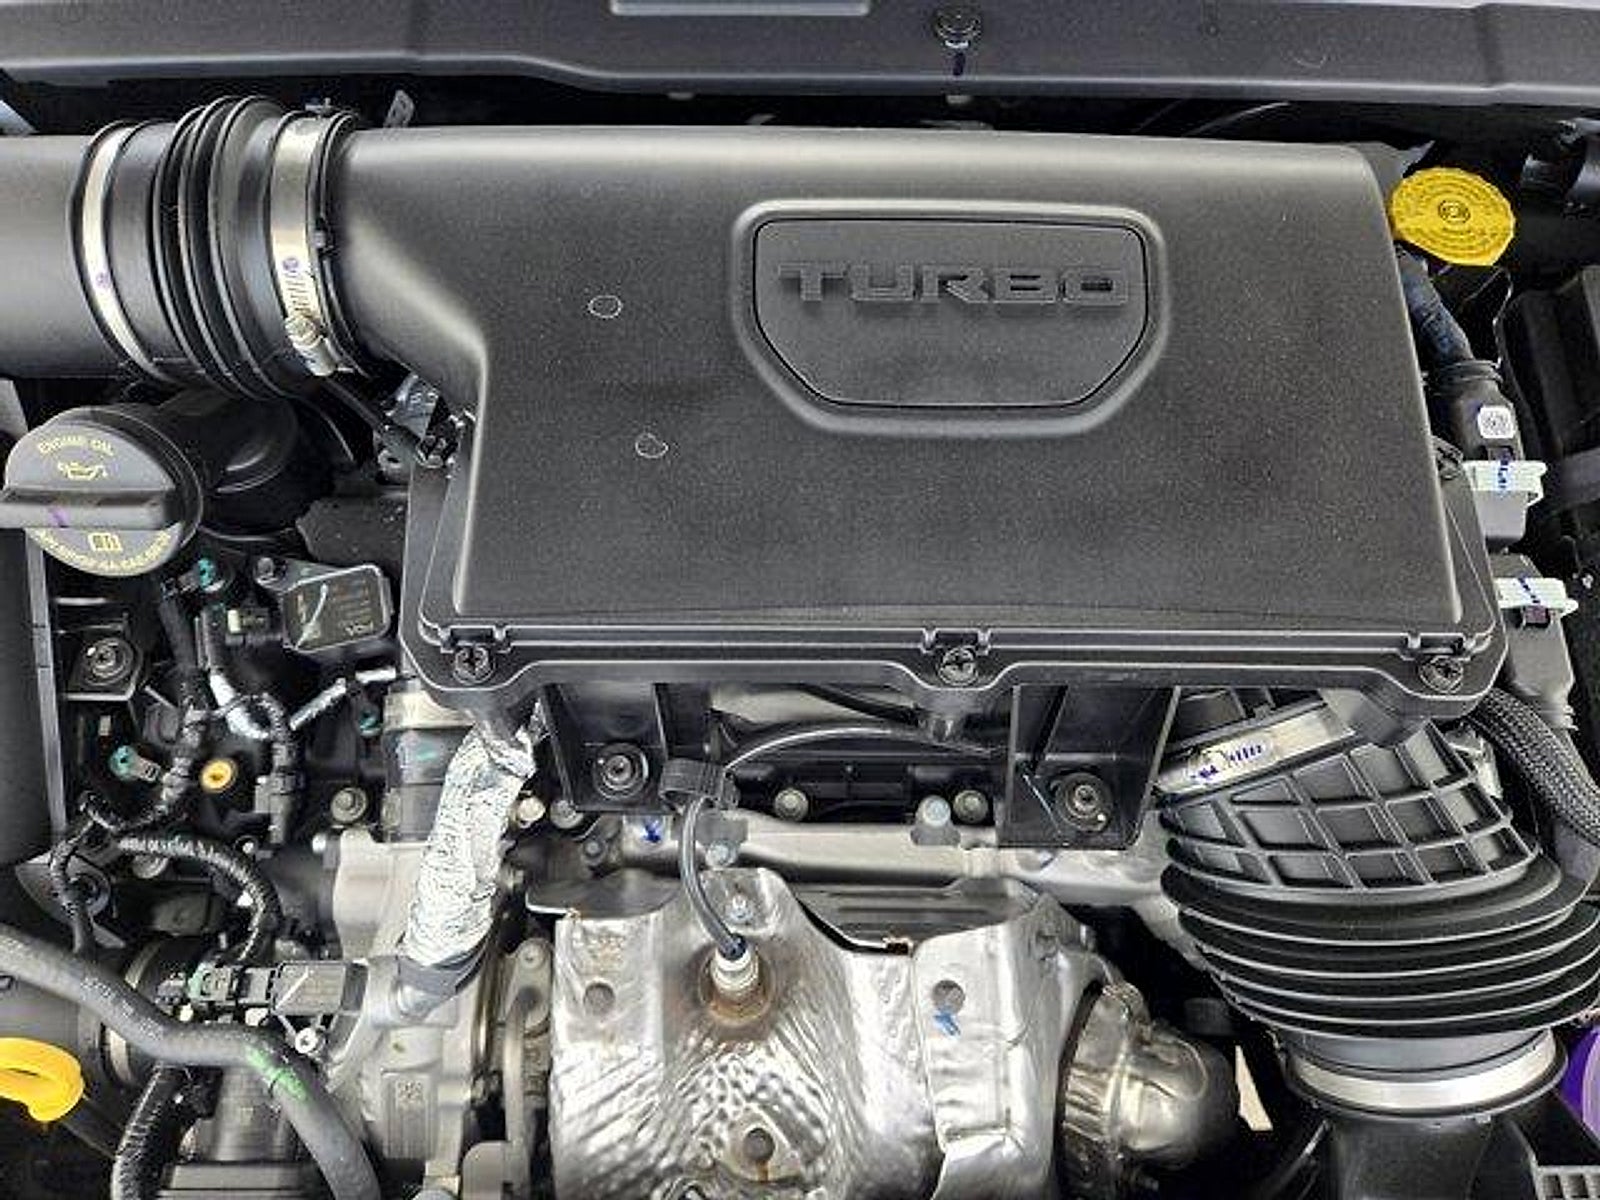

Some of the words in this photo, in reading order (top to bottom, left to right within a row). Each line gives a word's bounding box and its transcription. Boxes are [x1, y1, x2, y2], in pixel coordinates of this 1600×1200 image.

[777, 261, 1128, 305] TURBO
[37, 434, 83, 455] ENGINE
[90, 438, 115, 457] OIL
